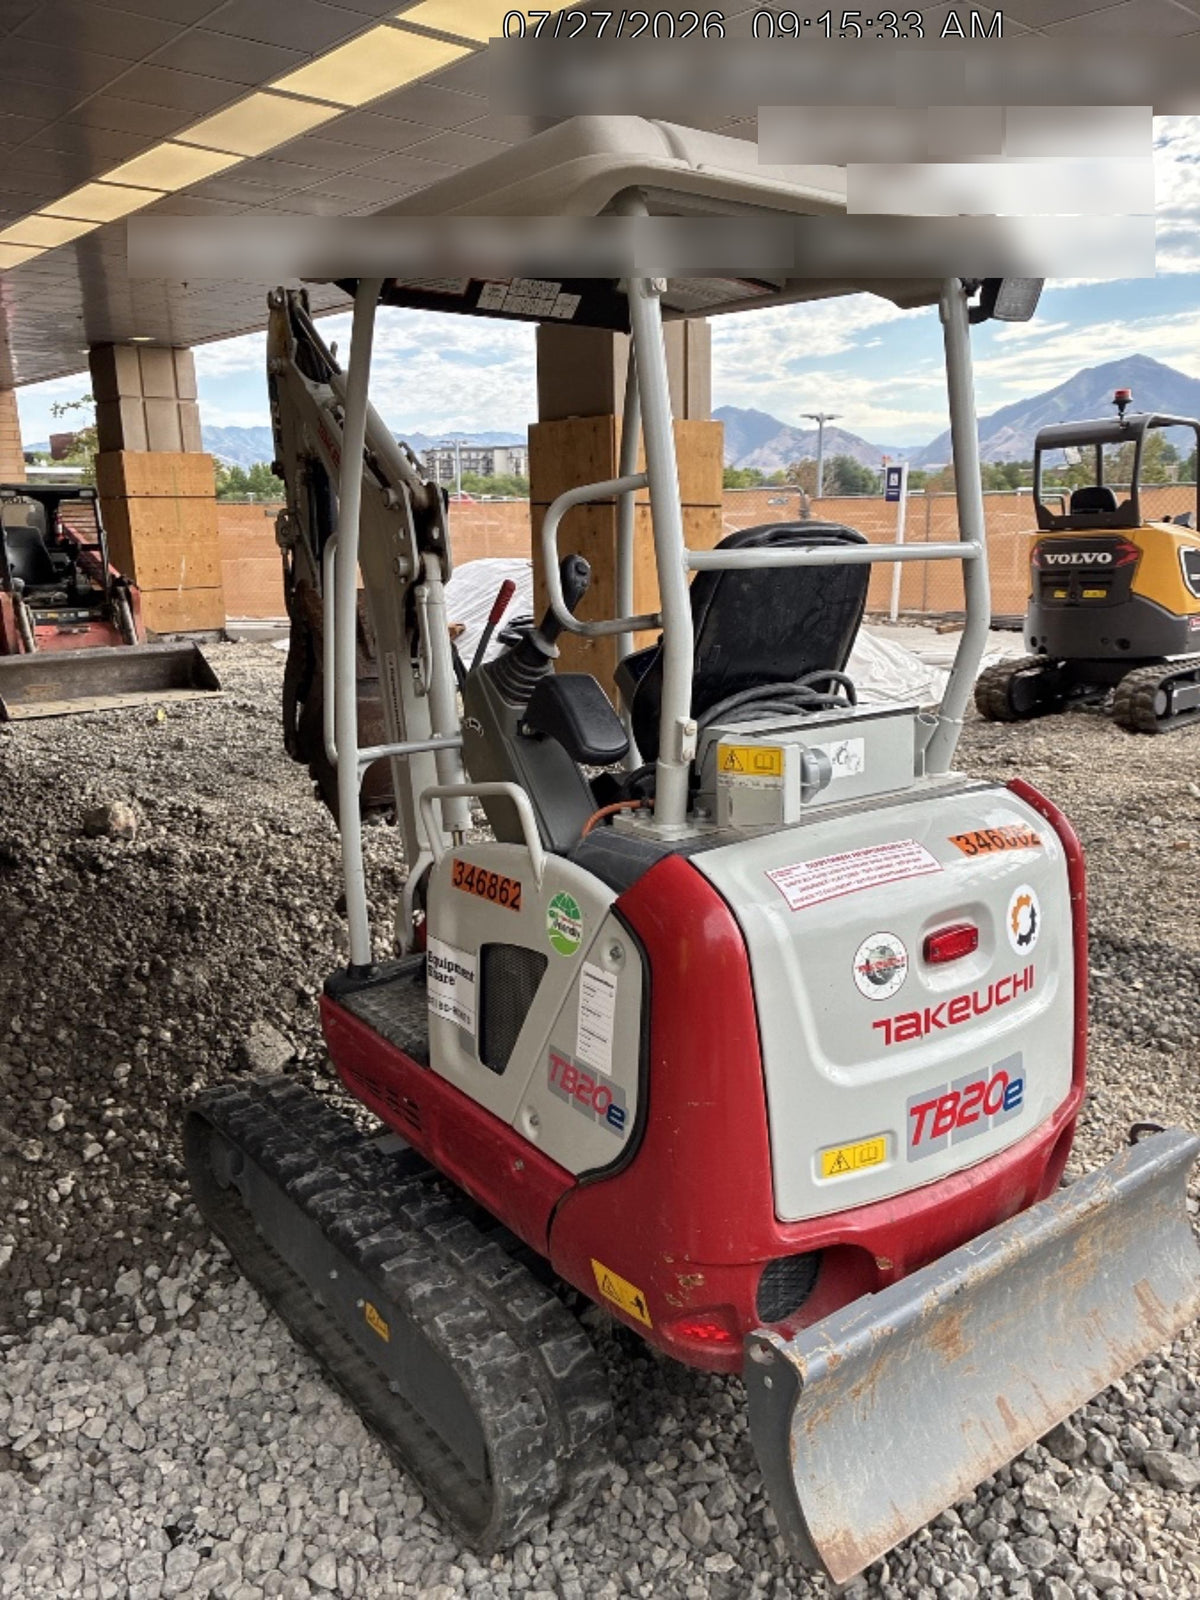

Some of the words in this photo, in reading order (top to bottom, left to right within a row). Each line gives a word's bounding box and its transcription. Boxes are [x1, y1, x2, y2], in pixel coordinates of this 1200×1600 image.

[1044, 552, 1113, 565] VOLVO
[453, 861, 522, 912] 346862
[549, 1053, 626, 1131] TB20e
[909, 1070, 1023, 1146] TB20e
